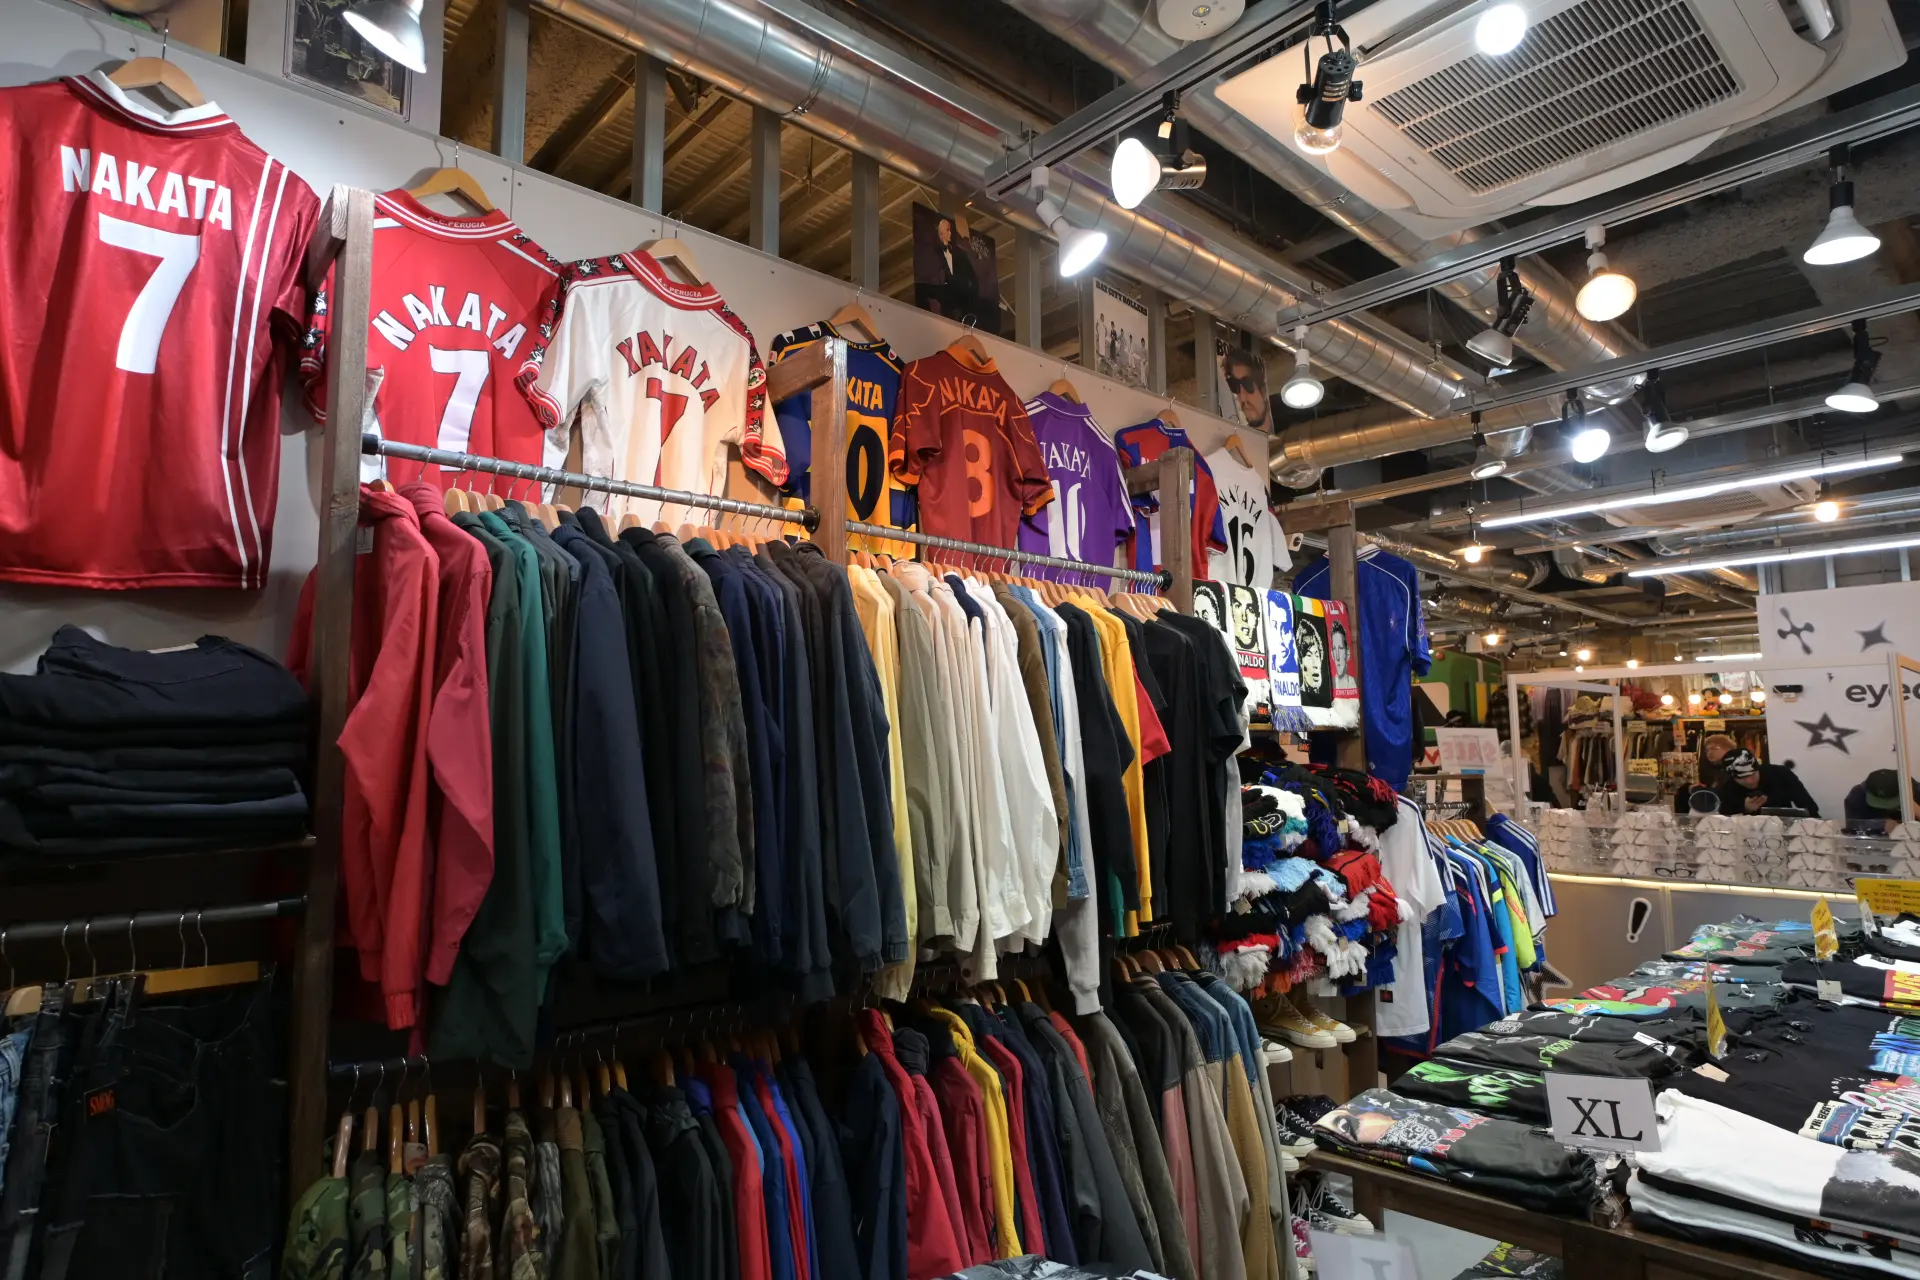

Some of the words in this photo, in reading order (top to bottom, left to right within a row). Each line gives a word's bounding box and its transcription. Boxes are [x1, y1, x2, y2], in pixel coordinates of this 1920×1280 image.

[60, 144, 233, 231] NAKATA
[448, 221, 486, 229] PERUGIA
[98, 212, 200, 374] 7
[371, 284, 528, 361] NAKATA
[669, 286, 702, 298] PERUGIA
[428, 343, 490, 473] 7
[846, 376, 883, 411] KATA
[646, 377, 689, 487] 7
[1047, 479, 1086, 562] 10
[1228, 515, 1255, 587] 16
[1238, 653, 1265, 668] NALDO
[1566, 1096, 1643, 1141] XL
